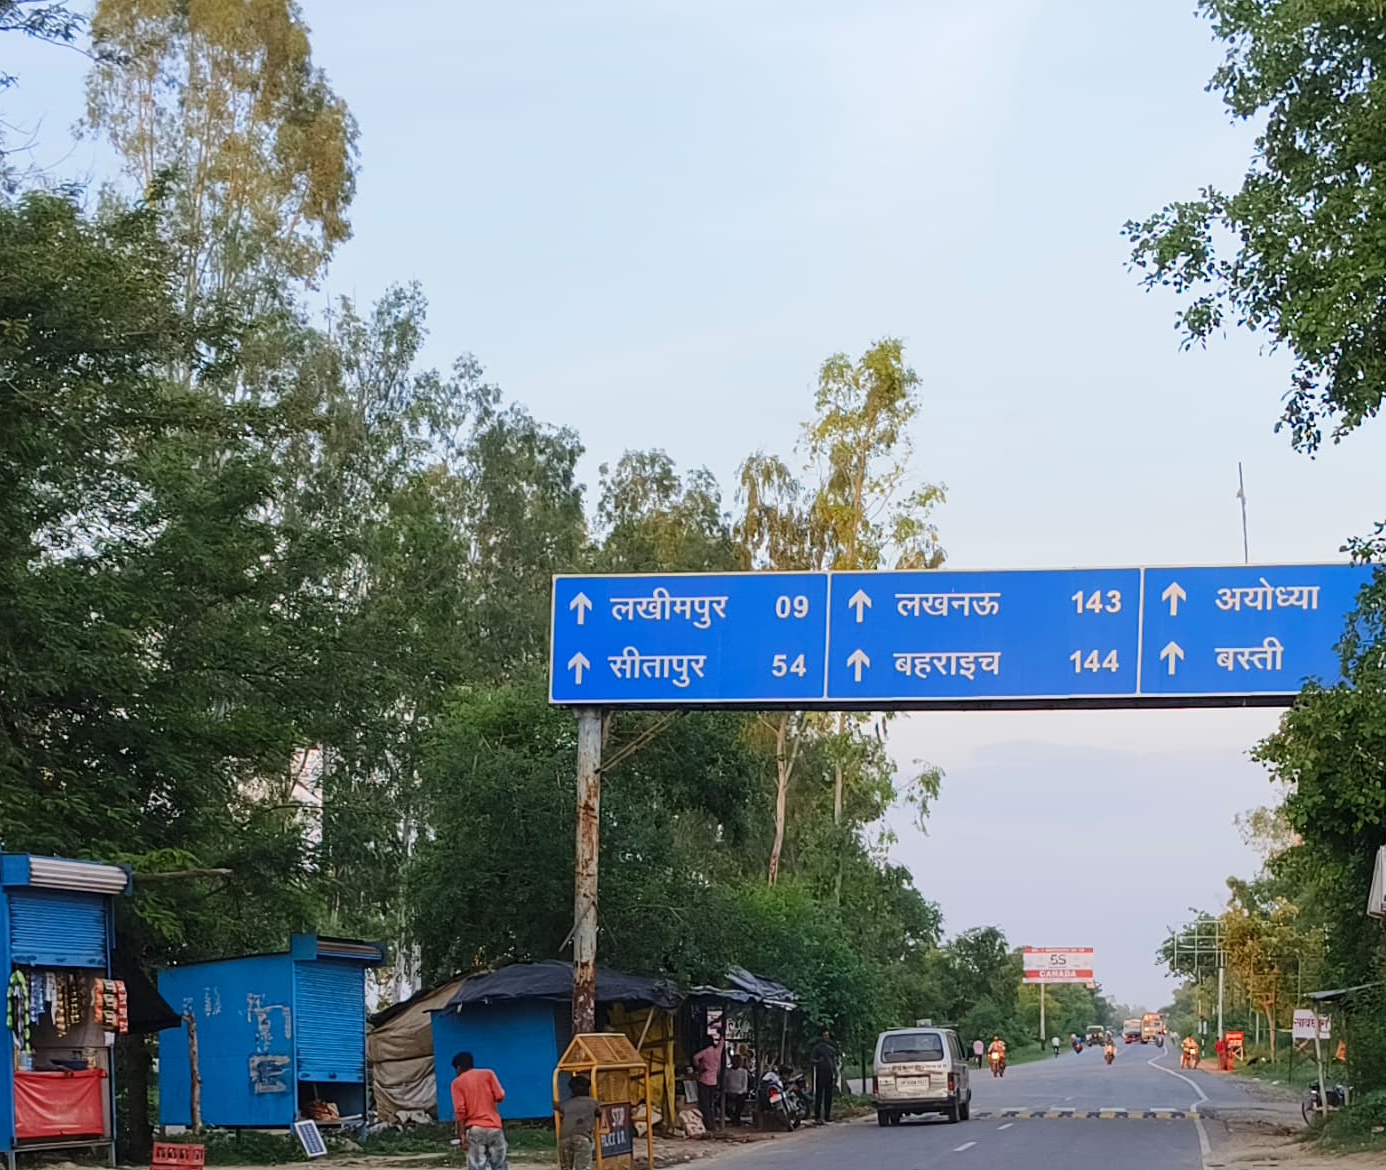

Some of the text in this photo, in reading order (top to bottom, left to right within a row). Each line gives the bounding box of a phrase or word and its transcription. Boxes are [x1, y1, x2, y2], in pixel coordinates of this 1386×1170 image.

[610, 587, 810, 630] लखीमपुर 09
[895, 590, 1122, 617] लखनऊ 143
[1215, 577, 1320, 611] अयोध्या
[607, 646, 808, 688] सीतापुर 54
[893, 649, 1120, 681] बहराइच 144
[1214, 636, 1284, 672] बस्ती
[1038, 969, 1078, 978] CANADA
